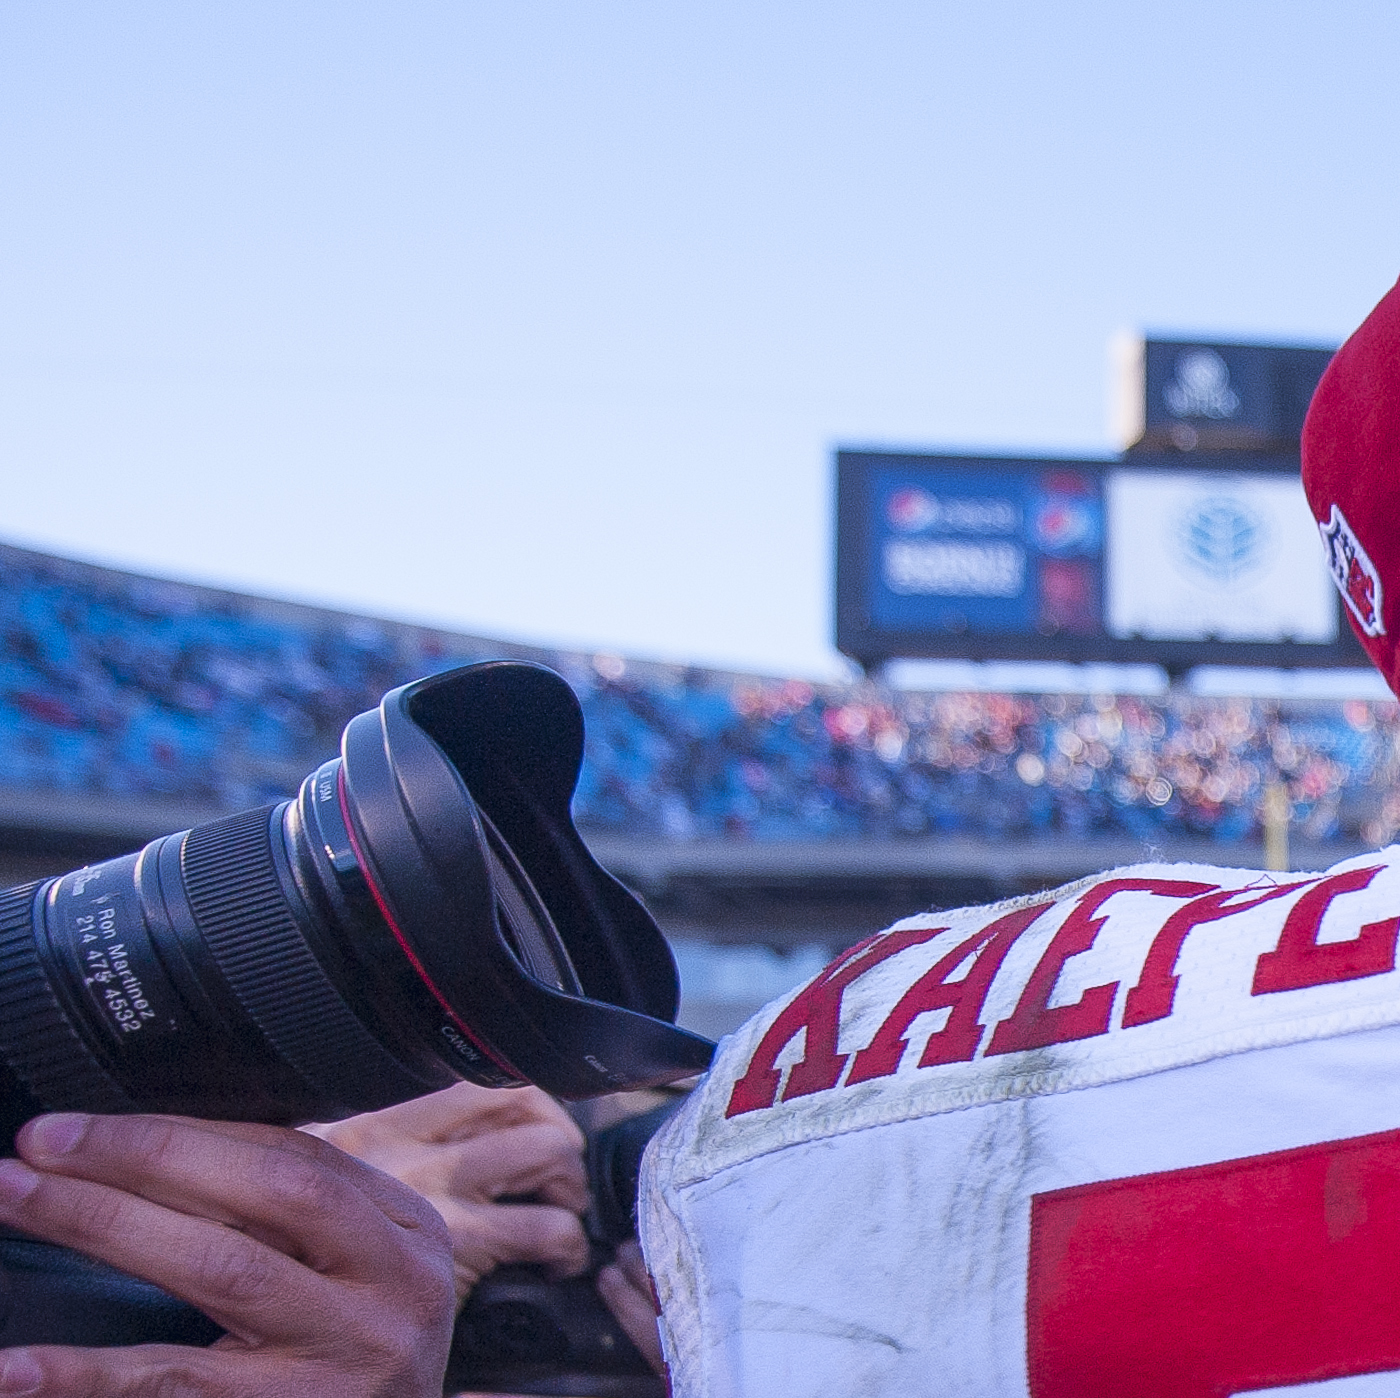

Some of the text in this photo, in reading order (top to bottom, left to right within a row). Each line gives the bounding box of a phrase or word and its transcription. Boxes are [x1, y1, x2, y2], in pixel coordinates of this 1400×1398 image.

[76, 915, 99, 944] 214
[105, 988, 142, 1033] 4532
[98, 908, 155, 1020] Ron Martinez
[441, 1026, 480, 1061] CANON
